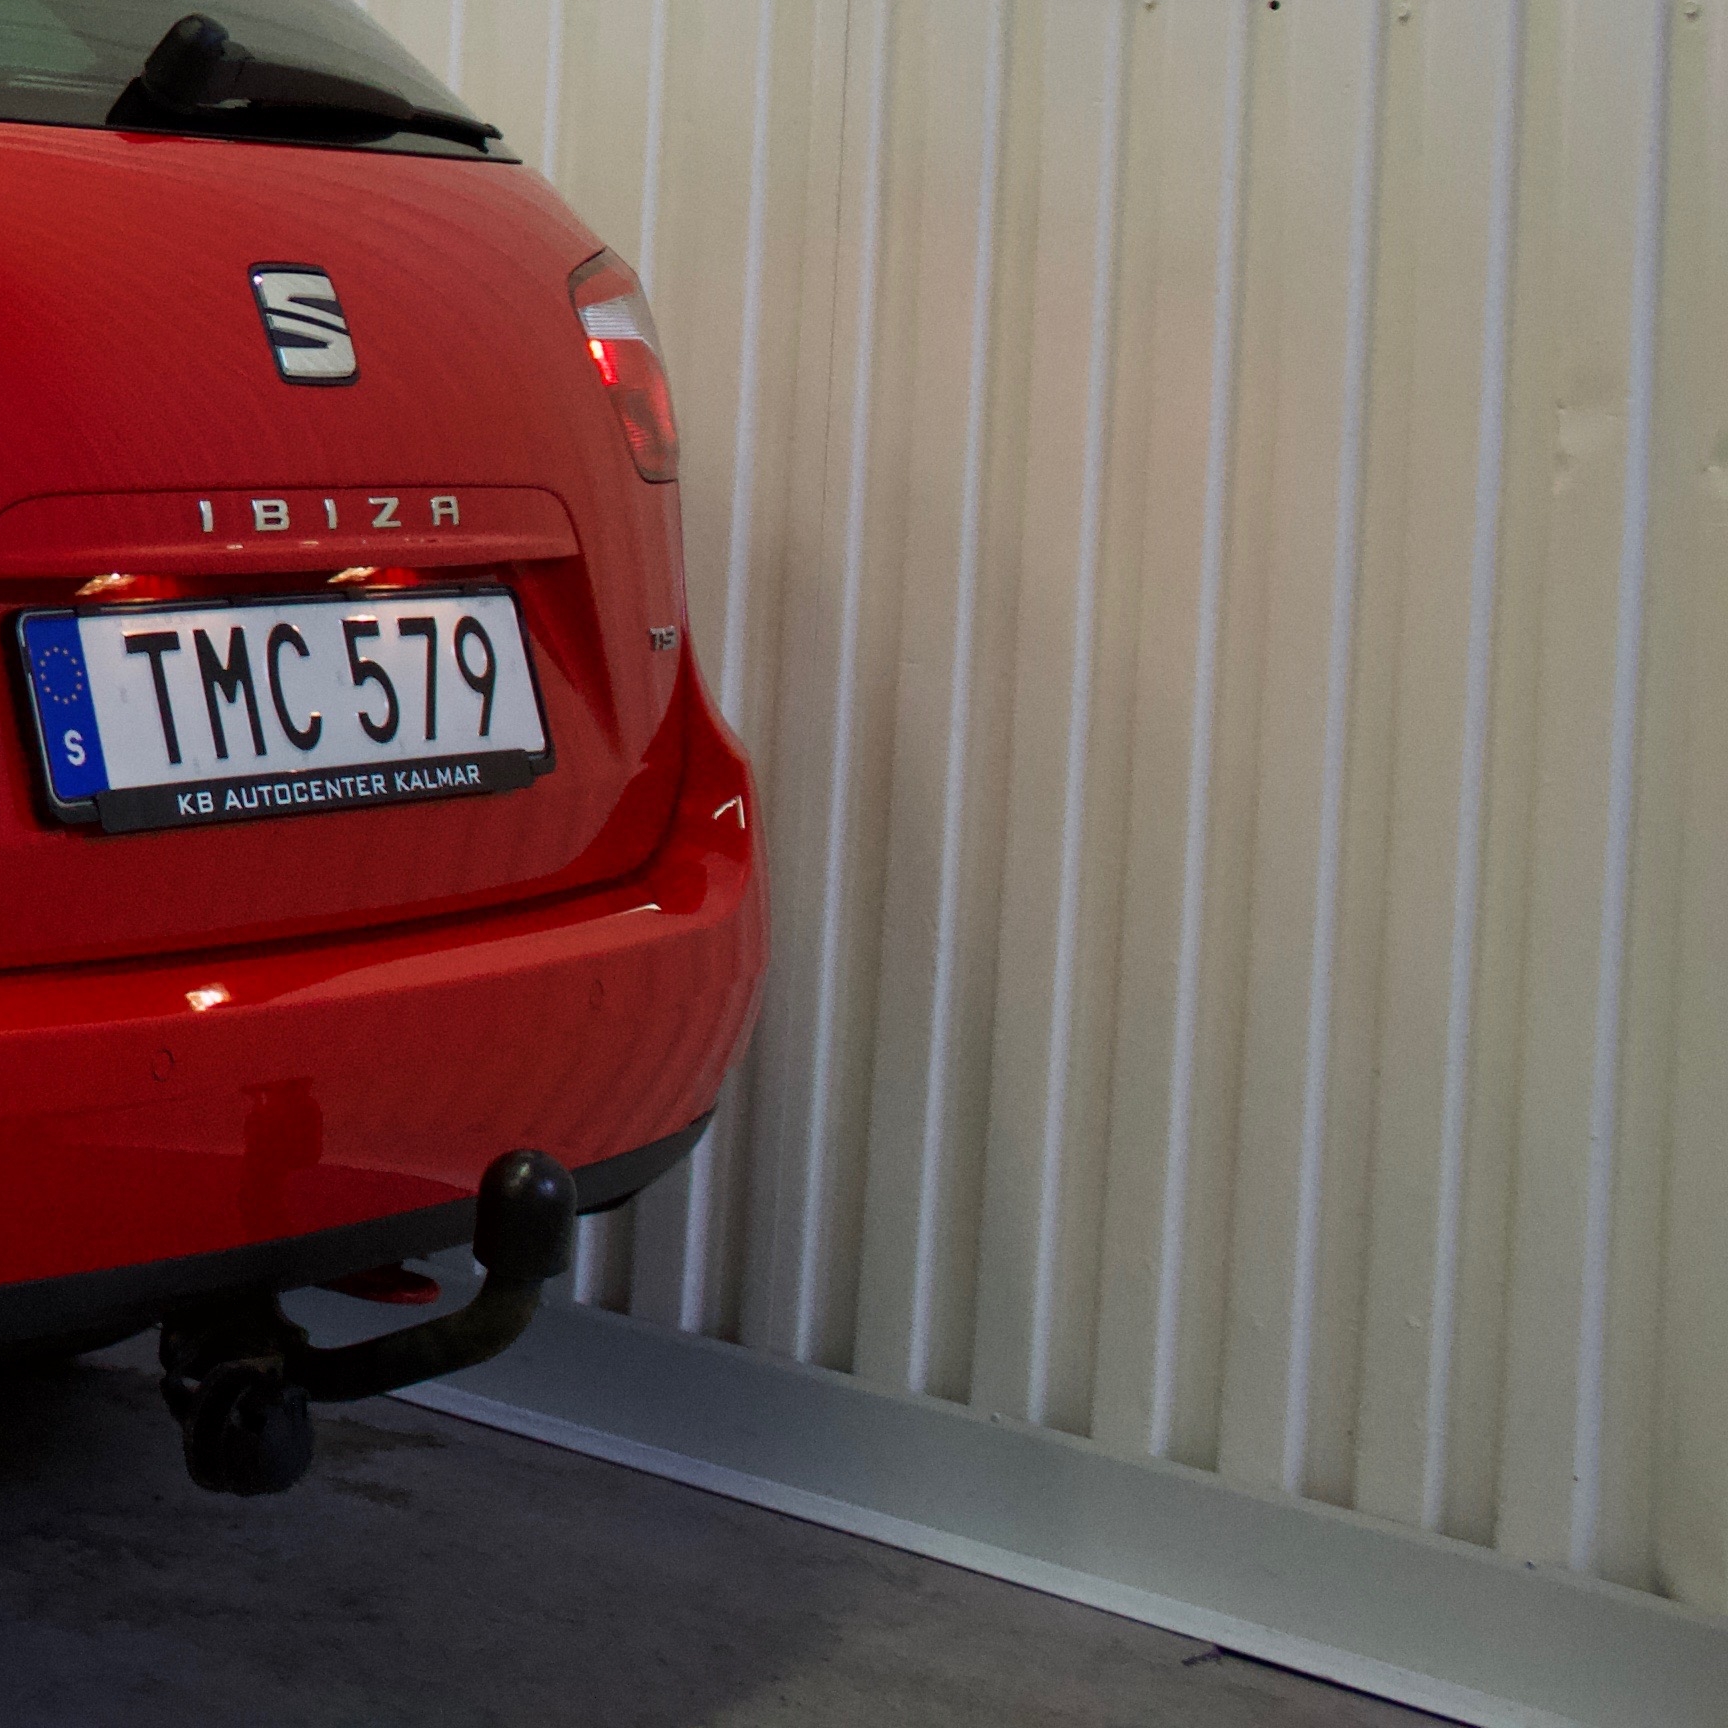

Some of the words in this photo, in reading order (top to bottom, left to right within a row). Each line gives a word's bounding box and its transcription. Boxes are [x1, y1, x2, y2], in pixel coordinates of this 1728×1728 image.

[198, 495, 462, 533] IBIZA
[124, 622, 323, 765] TMC
[342, 615, 497, 744] 579
[63, 728, 87, 767] S
[176, 791, 215, 816] KB
[224, 773, 388, 812] AUTOCENTER
[394, 764, 483, 794] KALMAR
